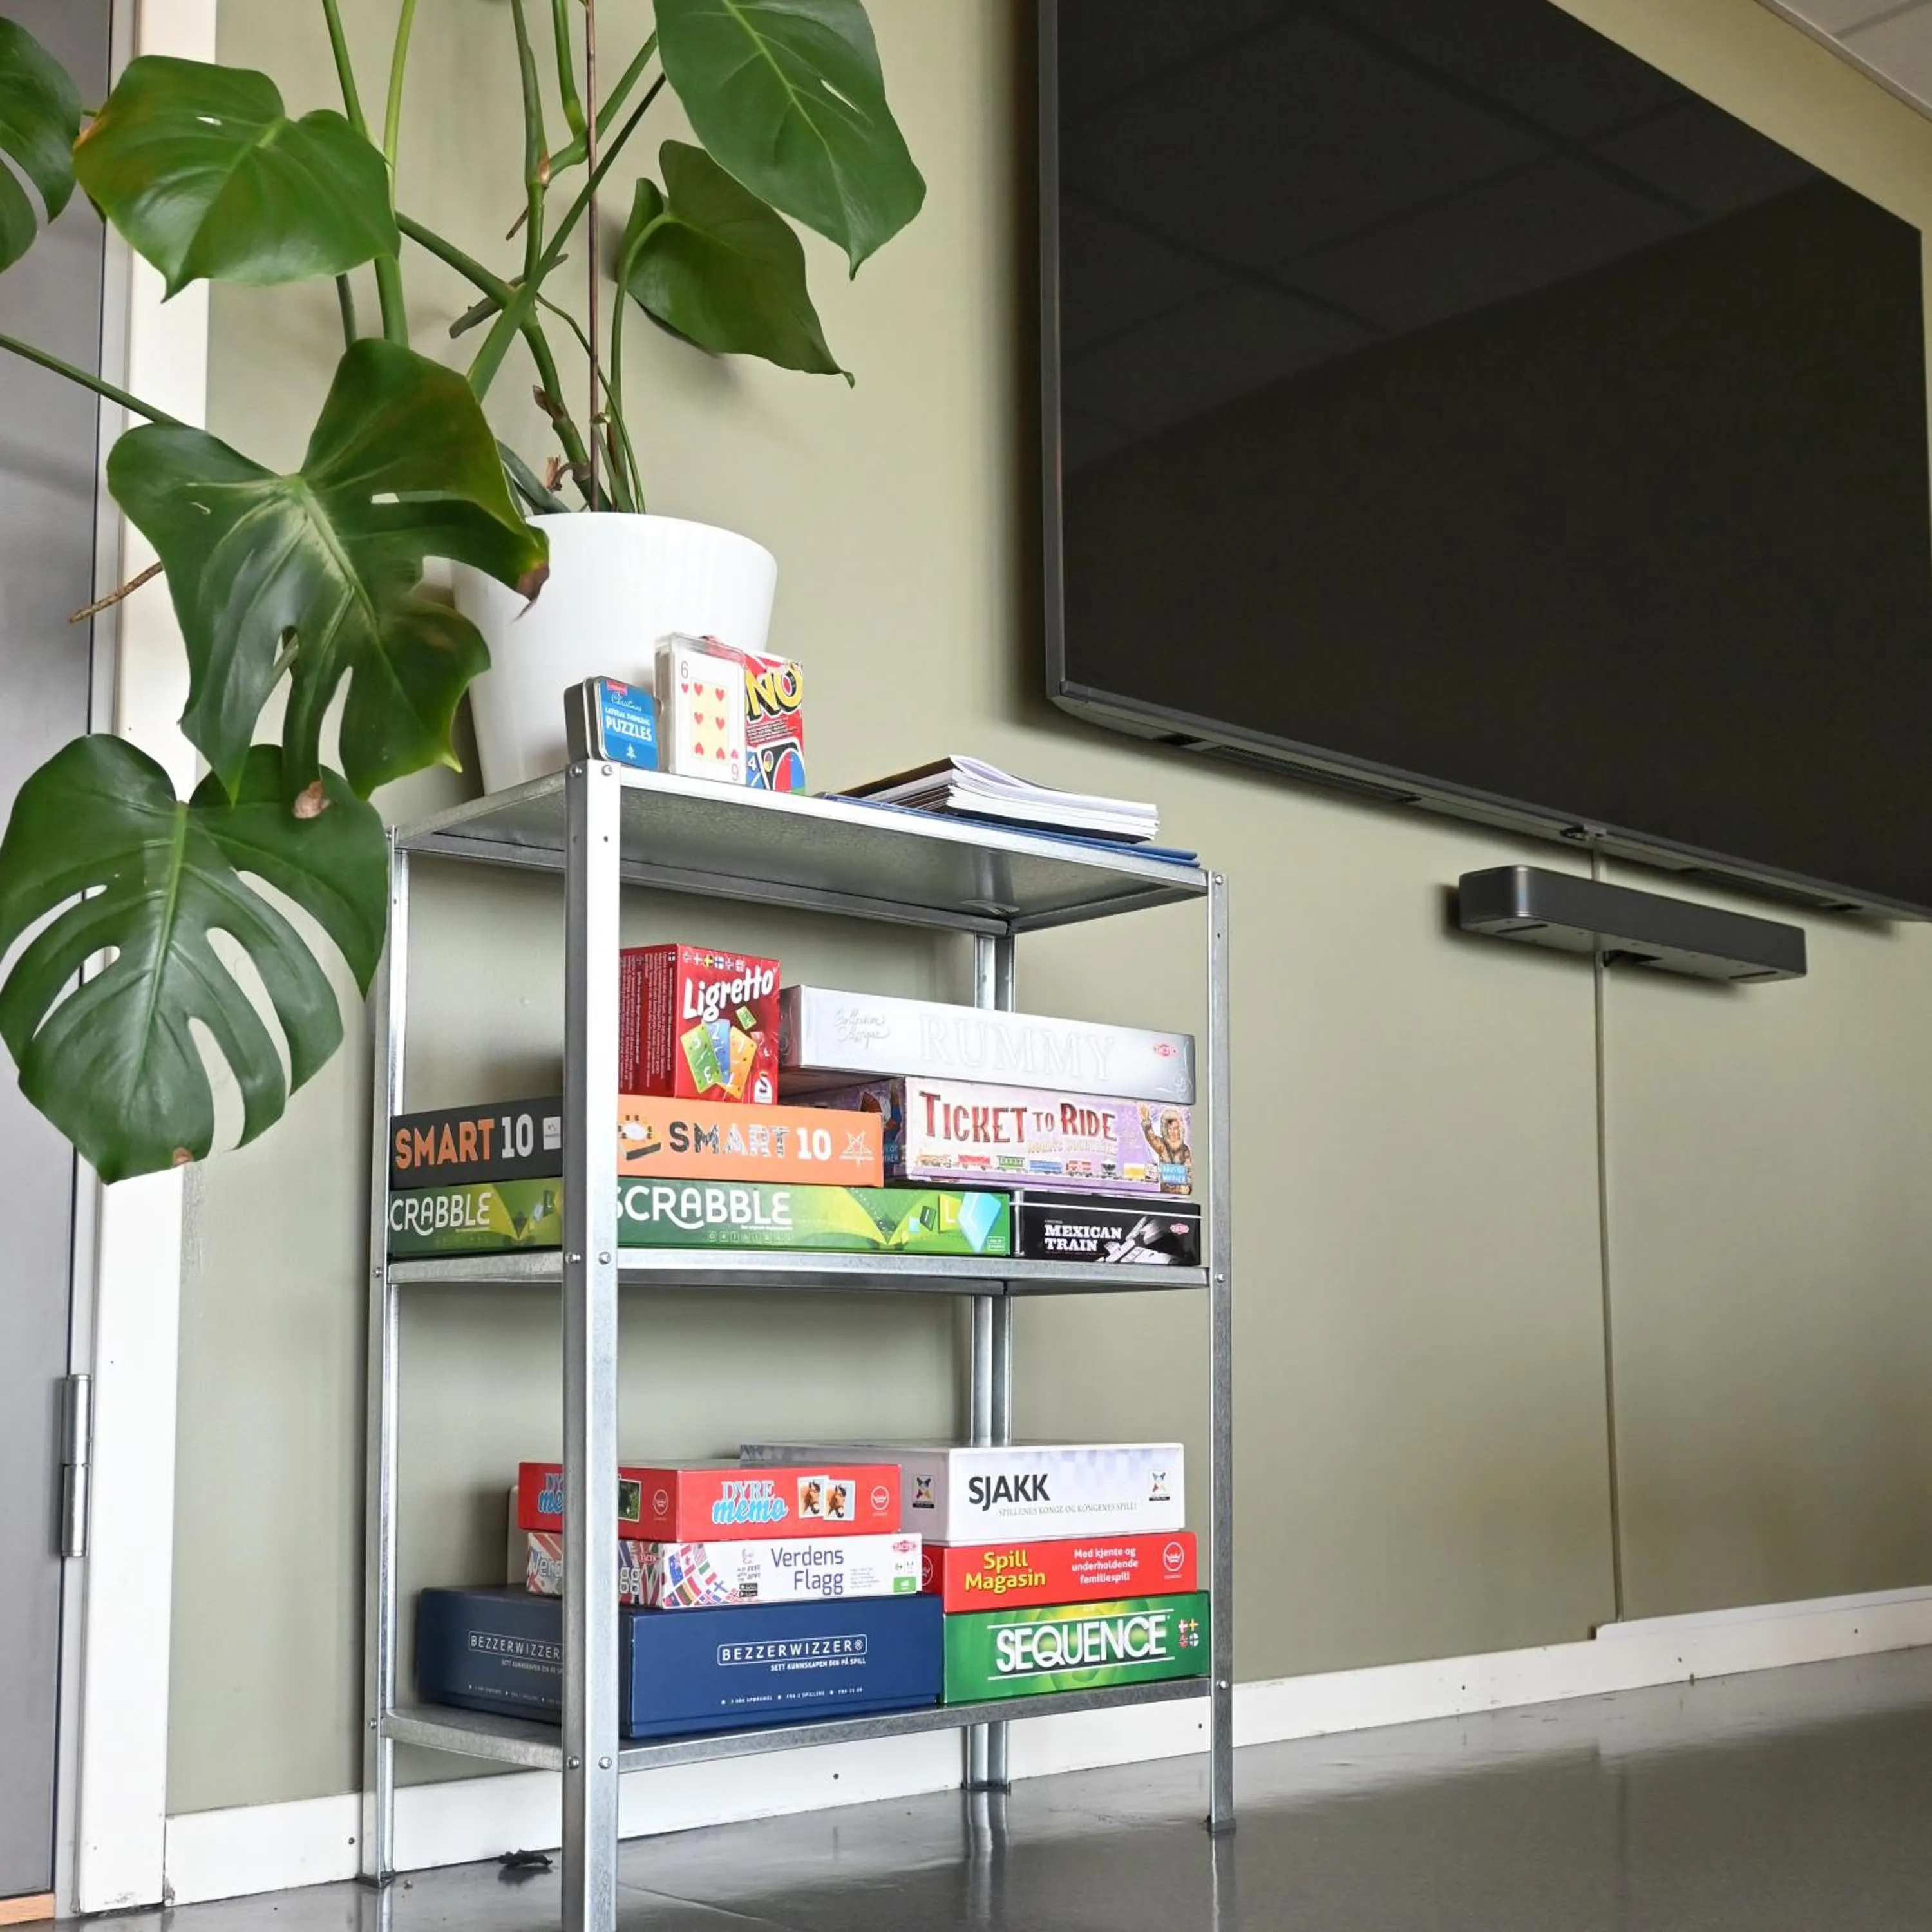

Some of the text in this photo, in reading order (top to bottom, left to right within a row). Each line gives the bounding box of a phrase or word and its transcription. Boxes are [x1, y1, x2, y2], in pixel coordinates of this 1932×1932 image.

[746, 663, 804, 719] NO
[606, 715, 652, 742] PUZZLES
[683, 964, 773, 1022] Ligretto
[918, 1013, 1115, 1081] RUMMY
[919, 1091, 1117, 1143] TICKET TO RIDE
[395, 1113, 534, 1170] SMART 10
[669, 1121, 832, 1162] SMART 10
[388, 1192, 492, 1236] CRABBLE
[1044, 1224, 1122, 1240] MEXICAN
[1044, 1238, 1098, 1251] TRAIN
[538, 1490, 564, 1513] me
[721, 1481, 775, 1500] DYRE
[969, 1473, 1051, 1511] SJAKK
[712, 1498, 789, 1524] memo
[528, 1548, 563, 1577] Verd
[771, 1546, 844, 1567] Verdens
[983, 1549, 1028, 1573] Spill
[1071, 1558, 1139, 1572] underholdende
[1074, 1547, 1137, 1559] Med kjente og
[794, 1569, 844, 1596] Flagg
[965, 1569, 1046, 1595] Magasin
[1079, 1571, 1131, 1585] familiespill
[471, 1635, 560, 1660] BEZZERWIZZER
[996, 1615, 1168, 1672] SEQUENCE
[770, 1663, 786, 1672] SETT
[786, 1660, 828, 1671] KUNNSKAPEN
[849, 1656, 866, 1665] SPILL
